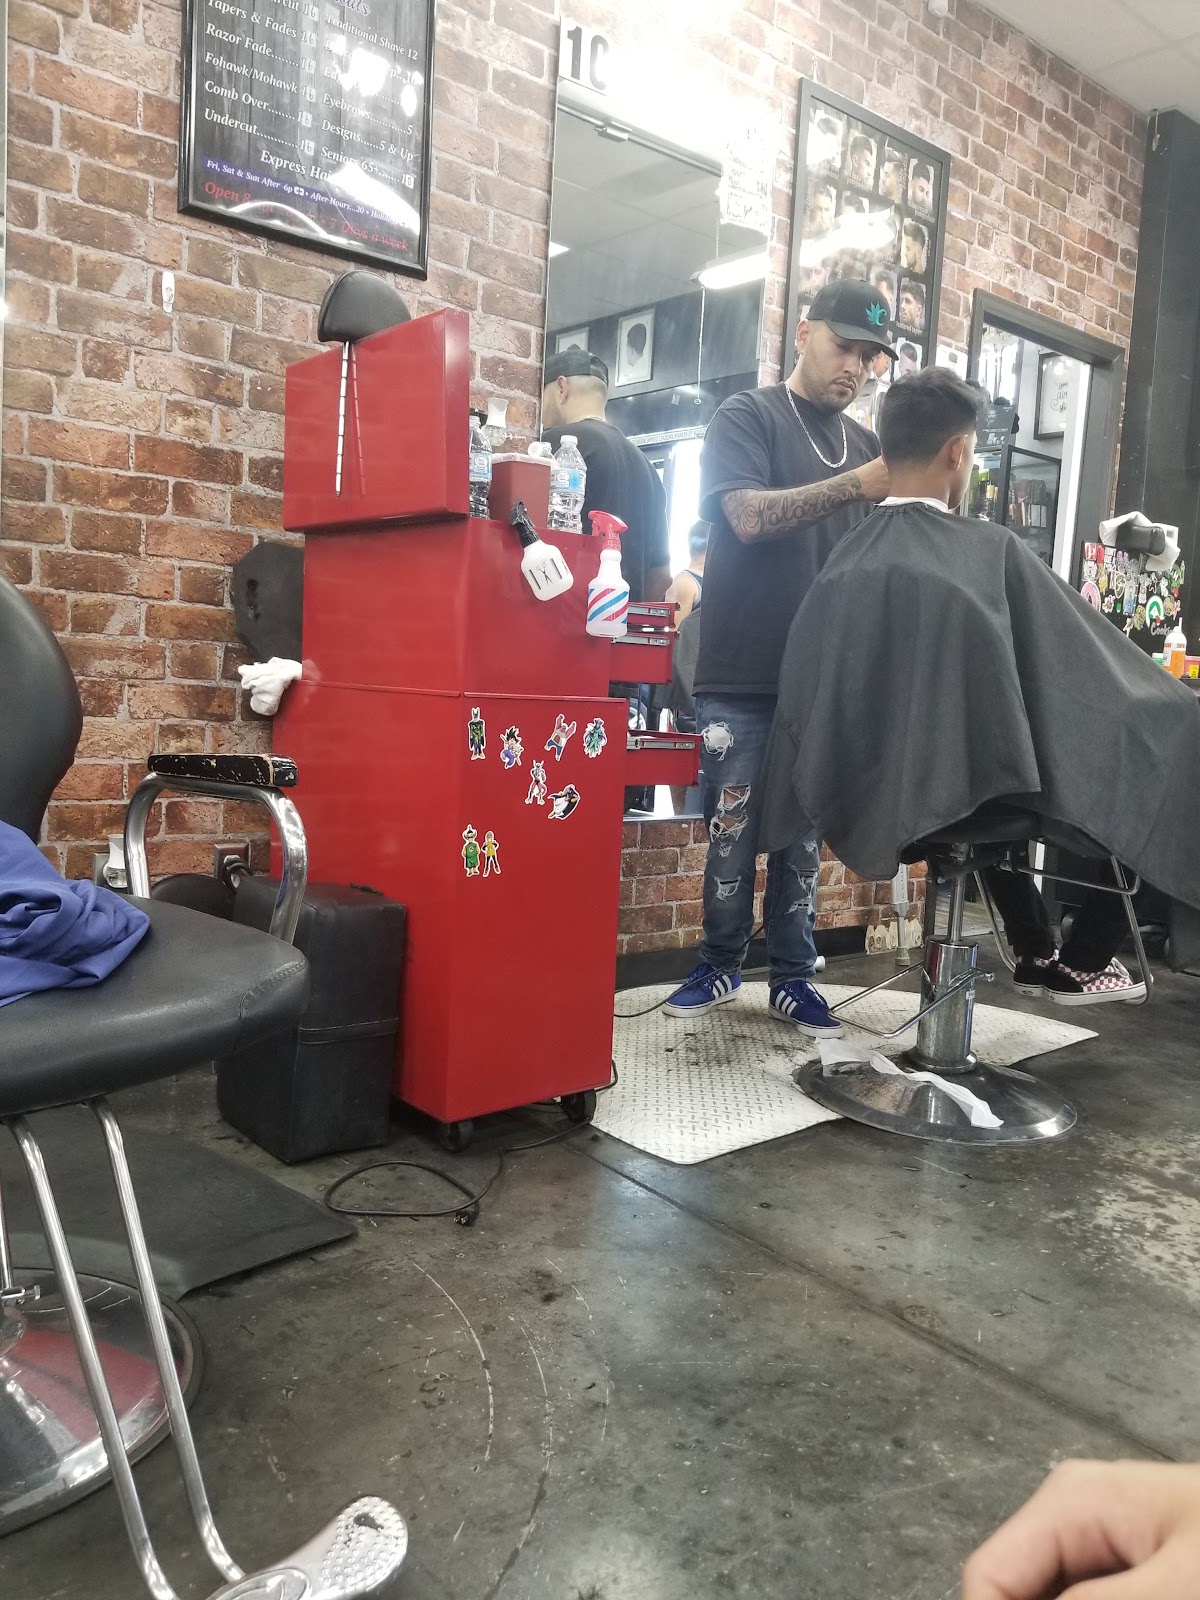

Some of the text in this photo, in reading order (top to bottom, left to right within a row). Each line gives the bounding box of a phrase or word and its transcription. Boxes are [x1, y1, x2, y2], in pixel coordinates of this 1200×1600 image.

[208, 0, 248, 19] Tapers
[251, 12, 261, 25] &
[265, 16, 297, 38] Fades
[205, 22, 242, 45] Razor
[326, 14, 418, 60] Traditional Shave 12
[205, 52, 298, 94] Fohawk/Mohawk
[205, 80, 239, 101] Comb
[260, 150, 307, 175] Express
[388, 144, 397, 156] &
[401, 148, 413, 162] Up
[207, 160, 220, 172] Fri,
[223, 164, 234, 175] Sat
[237, 169, 244, 178] &
[246, 172, 259, 183] Sun
[261, 178, 280, 188] After
[205, 181, 239, 202] Open
